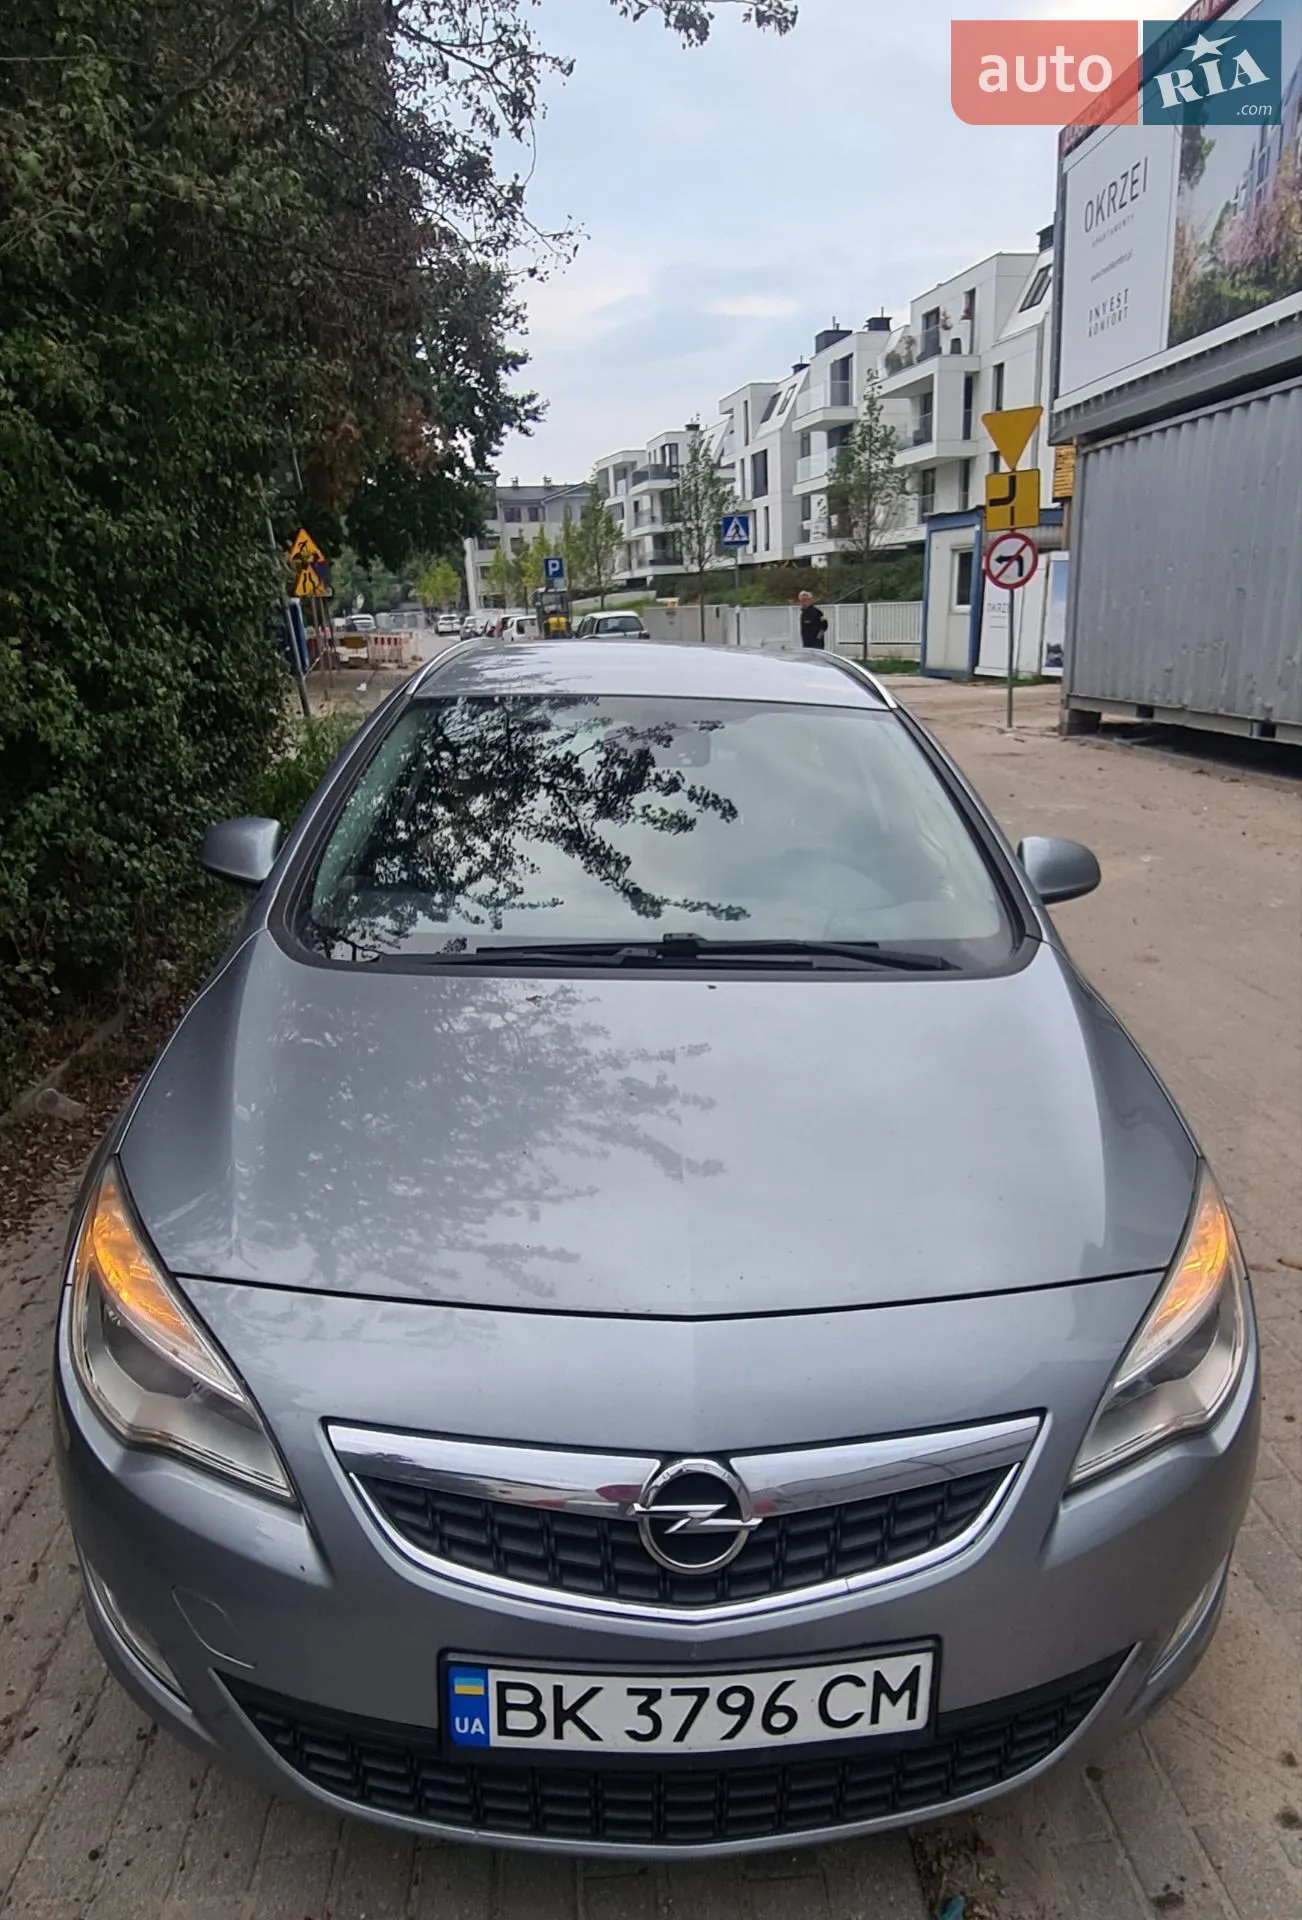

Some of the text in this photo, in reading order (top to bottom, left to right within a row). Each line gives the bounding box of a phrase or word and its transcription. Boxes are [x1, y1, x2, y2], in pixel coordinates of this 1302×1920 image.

[1084, 157, 1148, 233] OKRZEI
[1088, 288, 1129, 323] INVEST
[548, 559, 560, 576] P
[496, 1664, 922, 1742] BK 3796 CM
[455, 1717, 485, 1735] UA
